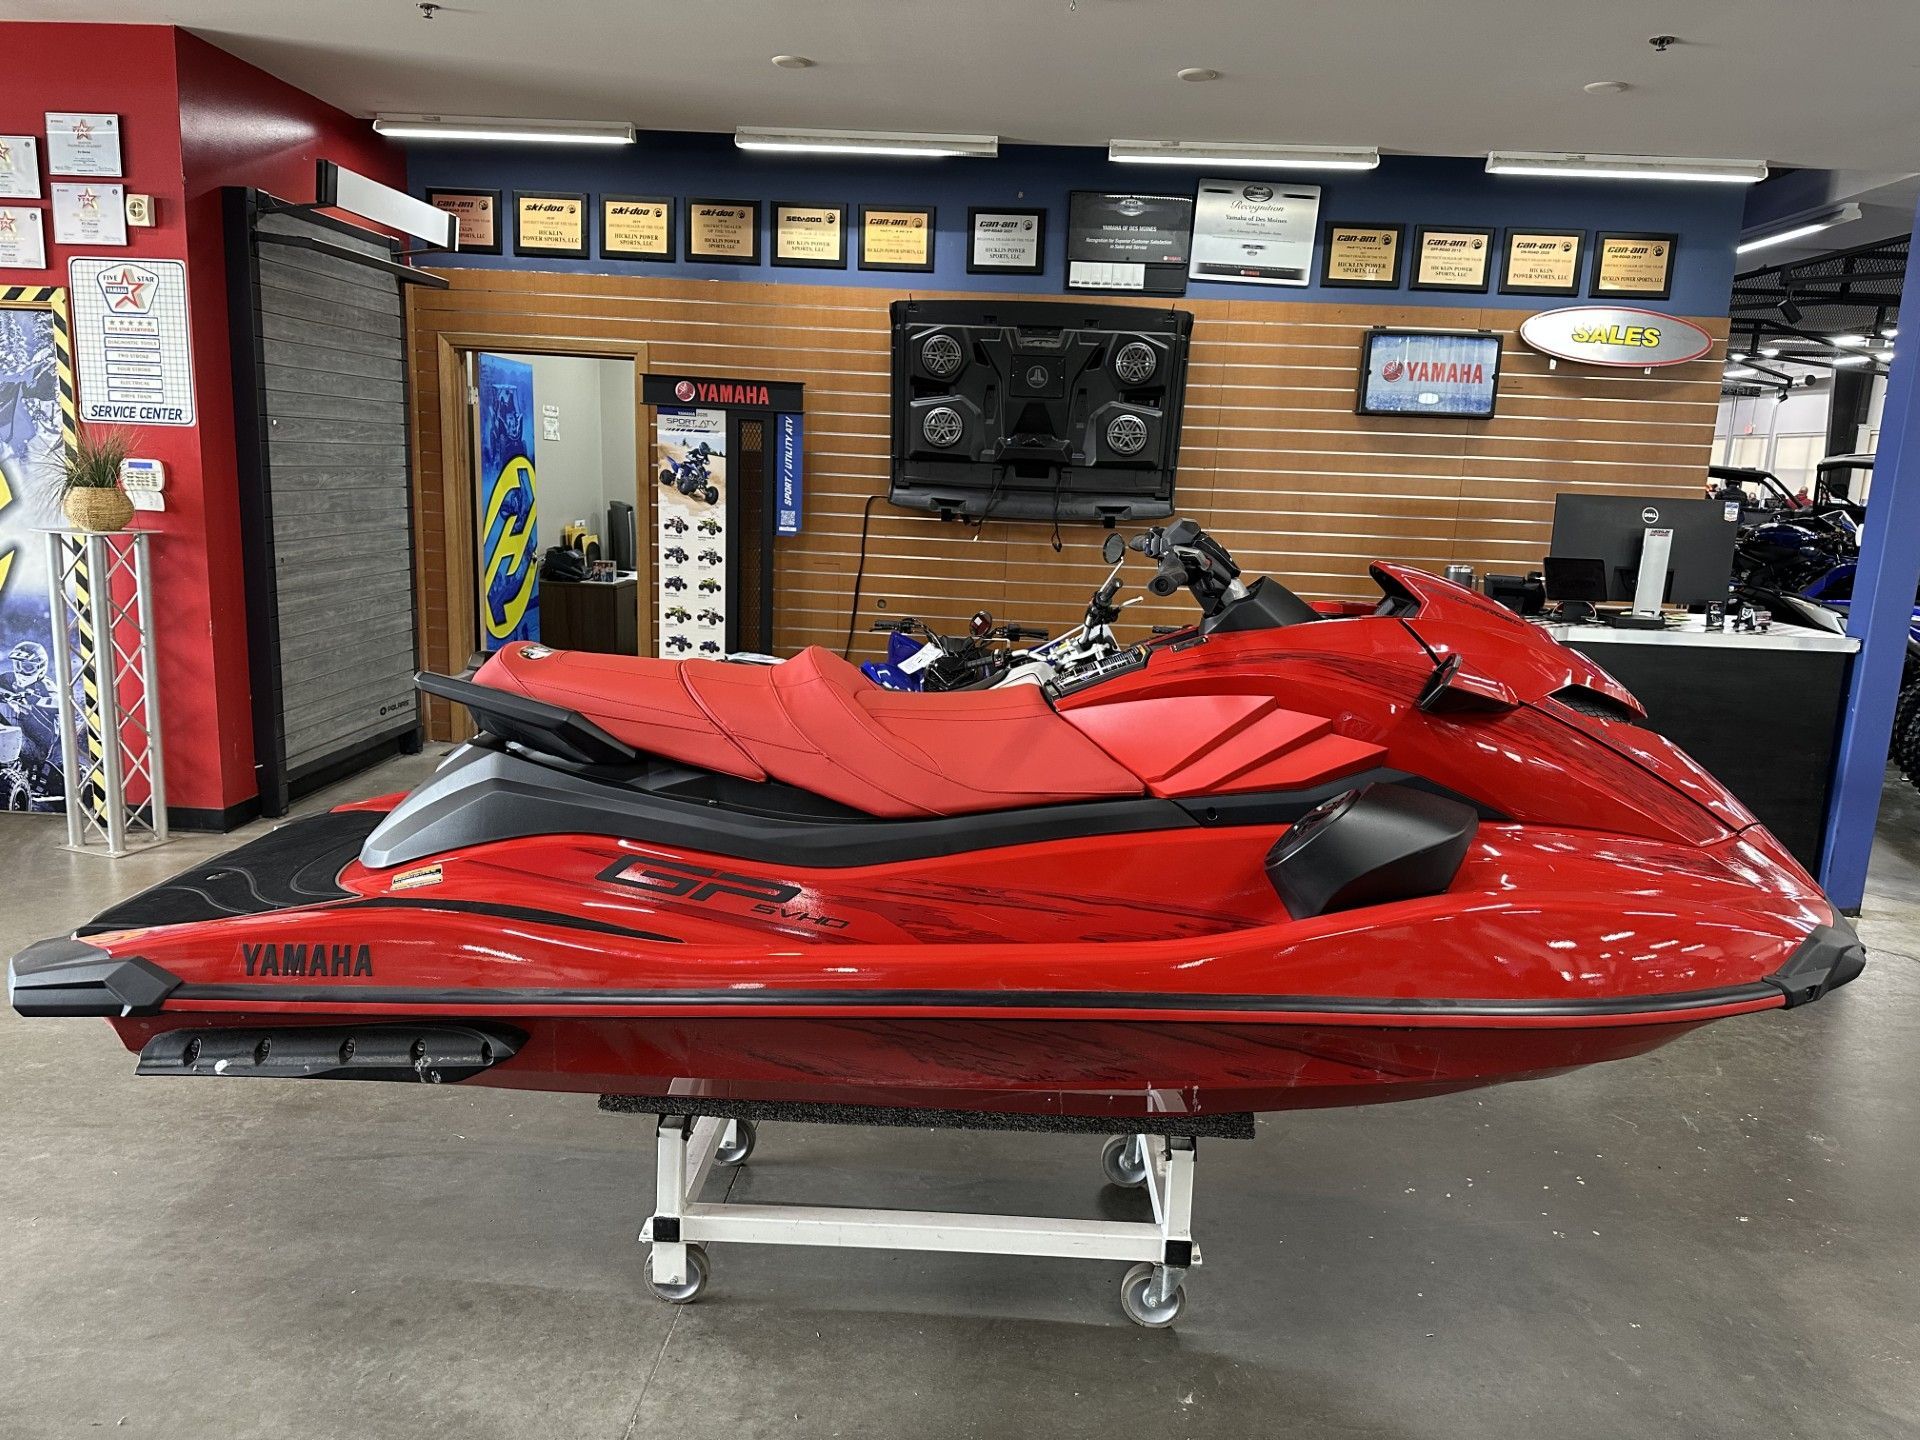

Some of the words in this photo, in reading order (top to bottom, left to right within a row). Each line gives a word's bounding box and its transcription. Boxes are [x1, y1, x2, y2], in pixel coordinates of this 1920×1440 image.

[437, 200, 474, 208] can-am
[525, 204, 564, 212] ski-doo
[610, 206, 650, 215] ski-doo
[700, 208, 735, 216] ski-doo
[1231, 200, 1284, 214] Recognition
[1336, 234, 1377, 242] can-am
[1427, 239, 1468, 247] can-am
[1572, 324, 1661, 348] SALES
[1406, 360, 1484, 384] YAMAHA
[697, 383, 770, 404] YAMAHA
[91, 405, 136, 418] SERVICE
[140, 407, 182, 420] CENTER
[784, 416, 794, 434] ATV
[784, 434, 793, 468] UTILITY
[784, 478, 792, 507] SPORT
[594, 854, 802, 904] GP
[750, 903, 850, 929] SVHO
[241, 943, 374, 978] YAMAHA
